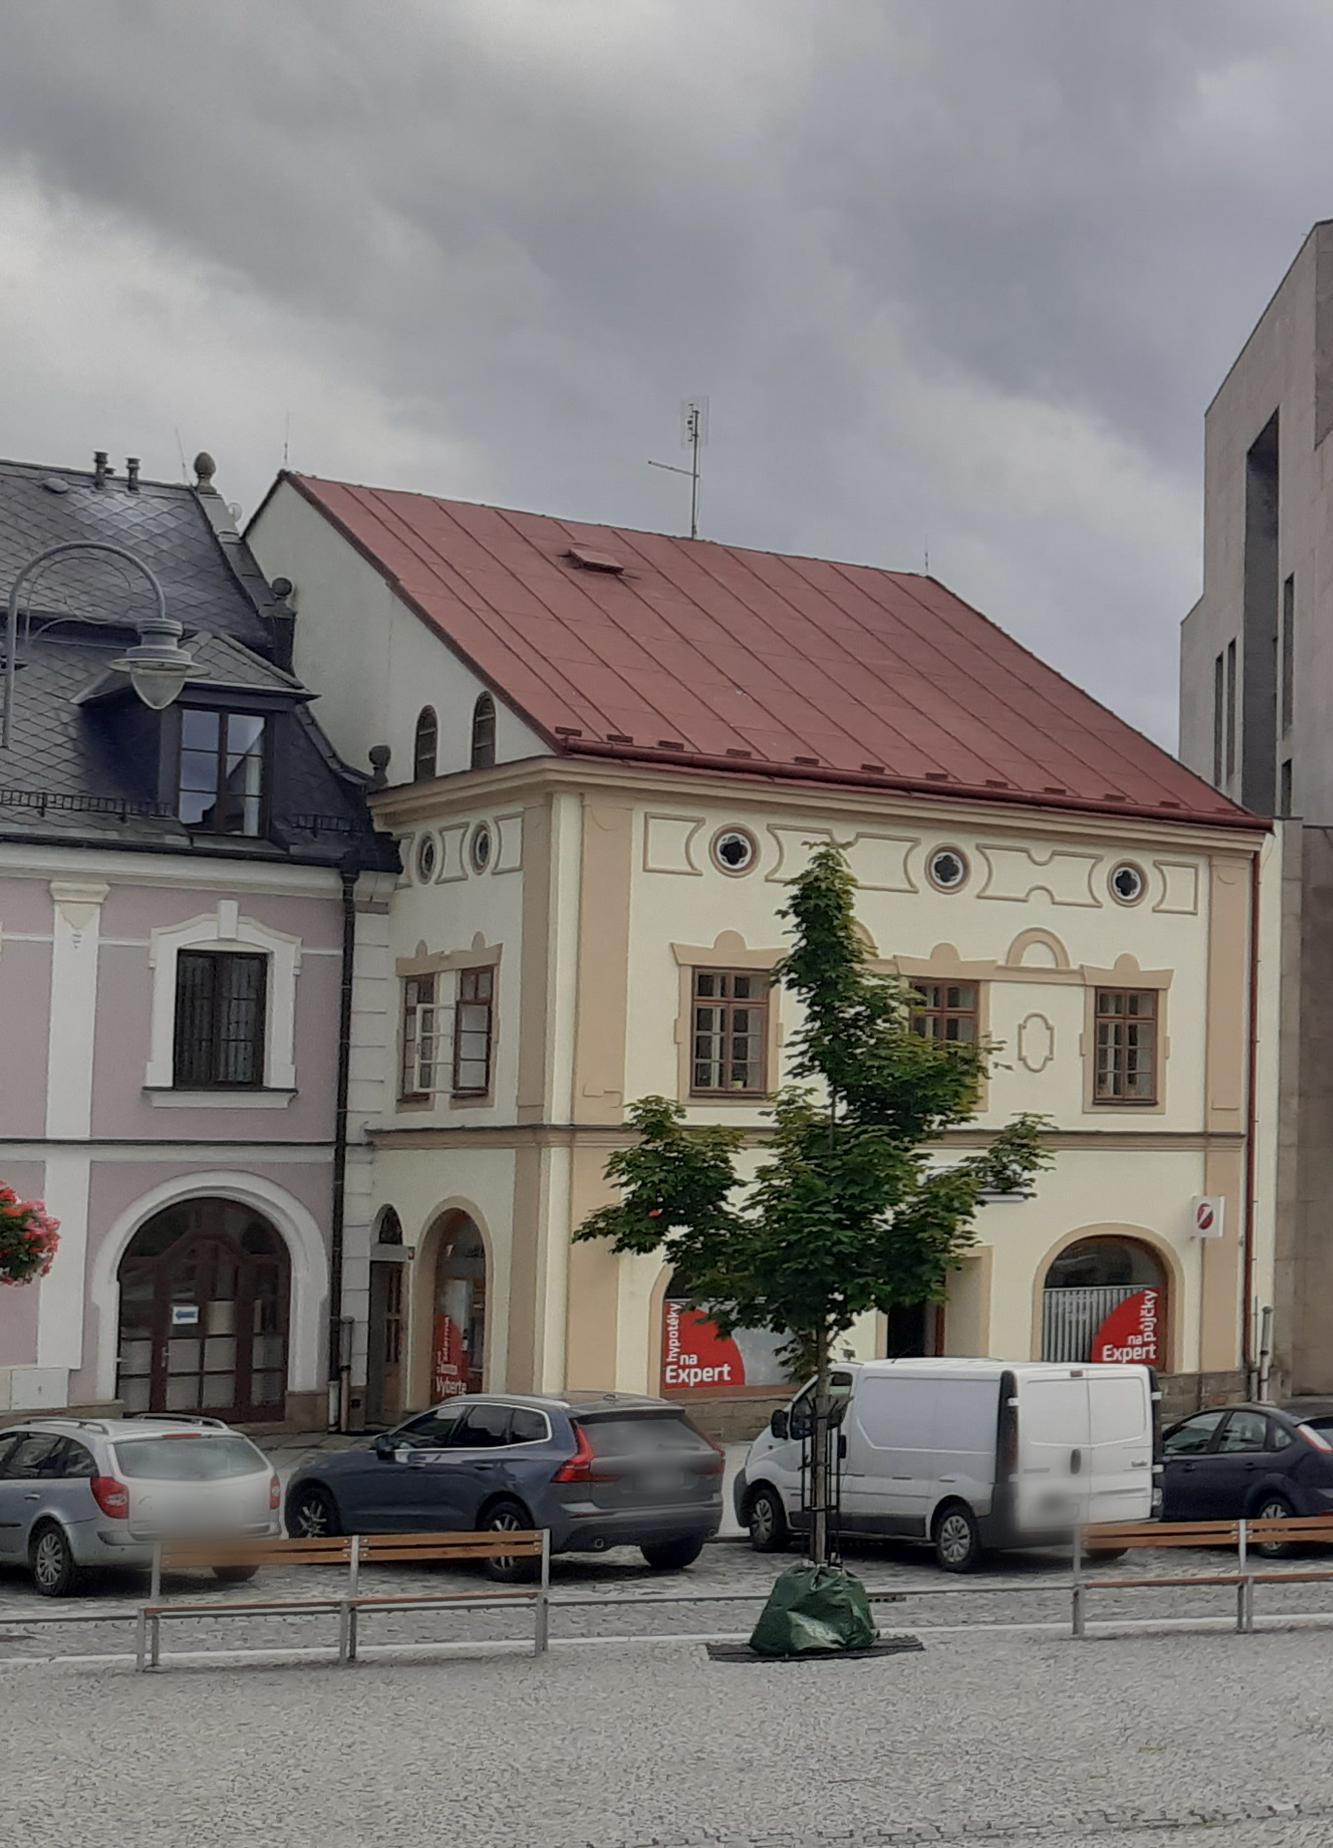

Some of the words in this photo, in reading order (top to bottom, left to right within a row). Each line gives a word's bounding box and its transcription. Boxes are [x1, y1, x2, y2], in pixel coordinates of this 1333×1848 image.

[1140, 1290, 1159, 1342] půjčky
[666, 1303, 681, 1362] hypotéky
[1128, 1335, 1142, 1345] na
[680, 1354, 698, 1366] na
[1102, 1343, 1157, 1363] Expert
[665, 1363, 731, 1387] Expert
